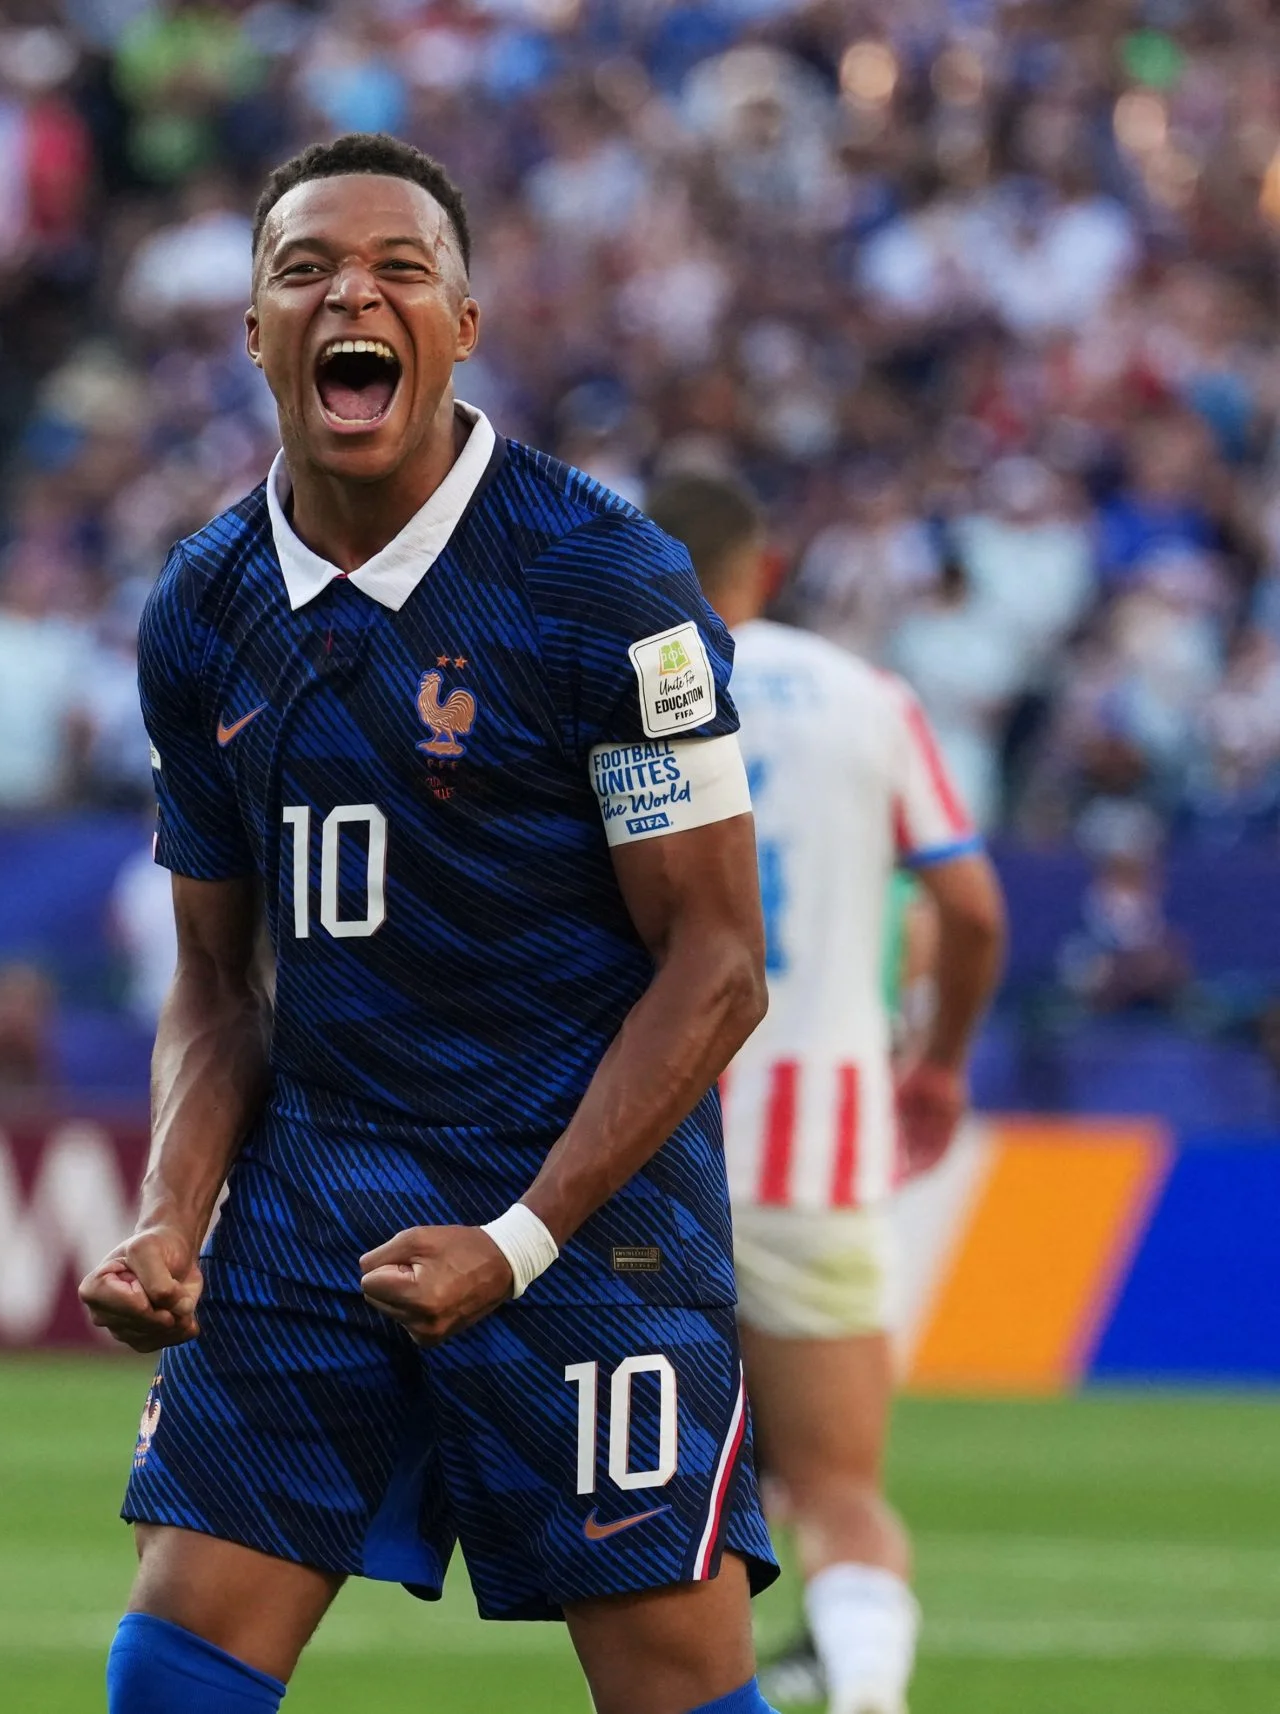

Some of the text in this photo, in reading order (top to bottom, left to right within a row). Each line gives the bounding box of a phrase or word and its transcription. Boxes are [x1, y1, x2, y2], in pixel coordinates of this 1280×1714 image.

[655, 685, 704, 714] EDUCATION
[660, 676, 684, 696] Unite
[674, 709, 694, 720] FIFA
[593, 741, 675, 772] FOOTBALL
[596, 757, 681, 797] UNITES
[602, 781, 692, 821] the World
[629, 816, 667, 832] FIFA
[283, 804, 388, 939] 10
[564, 1354, 678, 1495] 10
